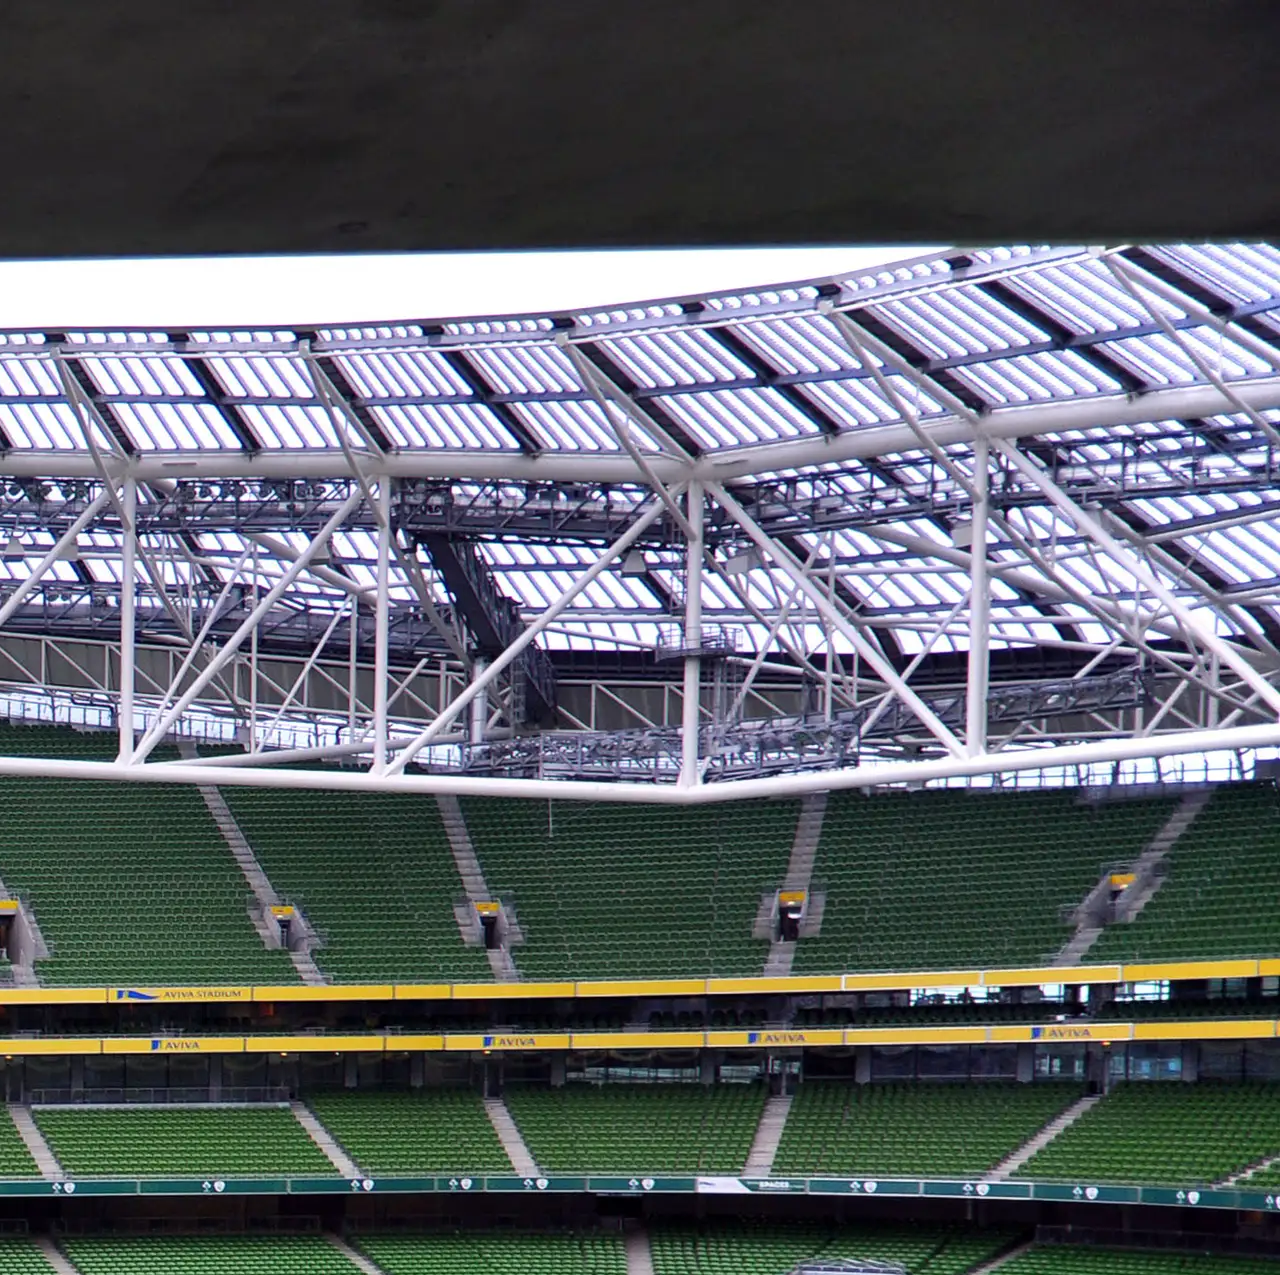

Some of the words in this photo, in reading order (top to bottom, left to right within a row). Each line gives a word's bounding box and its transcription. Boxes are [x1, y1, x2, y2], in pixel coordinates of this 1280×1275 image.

[163, 991, 194, 999] AVIVA
[196, 990, 242, 998] STADIUM
[764, 1033, 805, 1043] AVIVA
[1048, 1028, 1091, 1038] AVIVA
[165, 1041, 200, 1050] AVIVA
[498, 1037, 536, 1047] AVIVA
